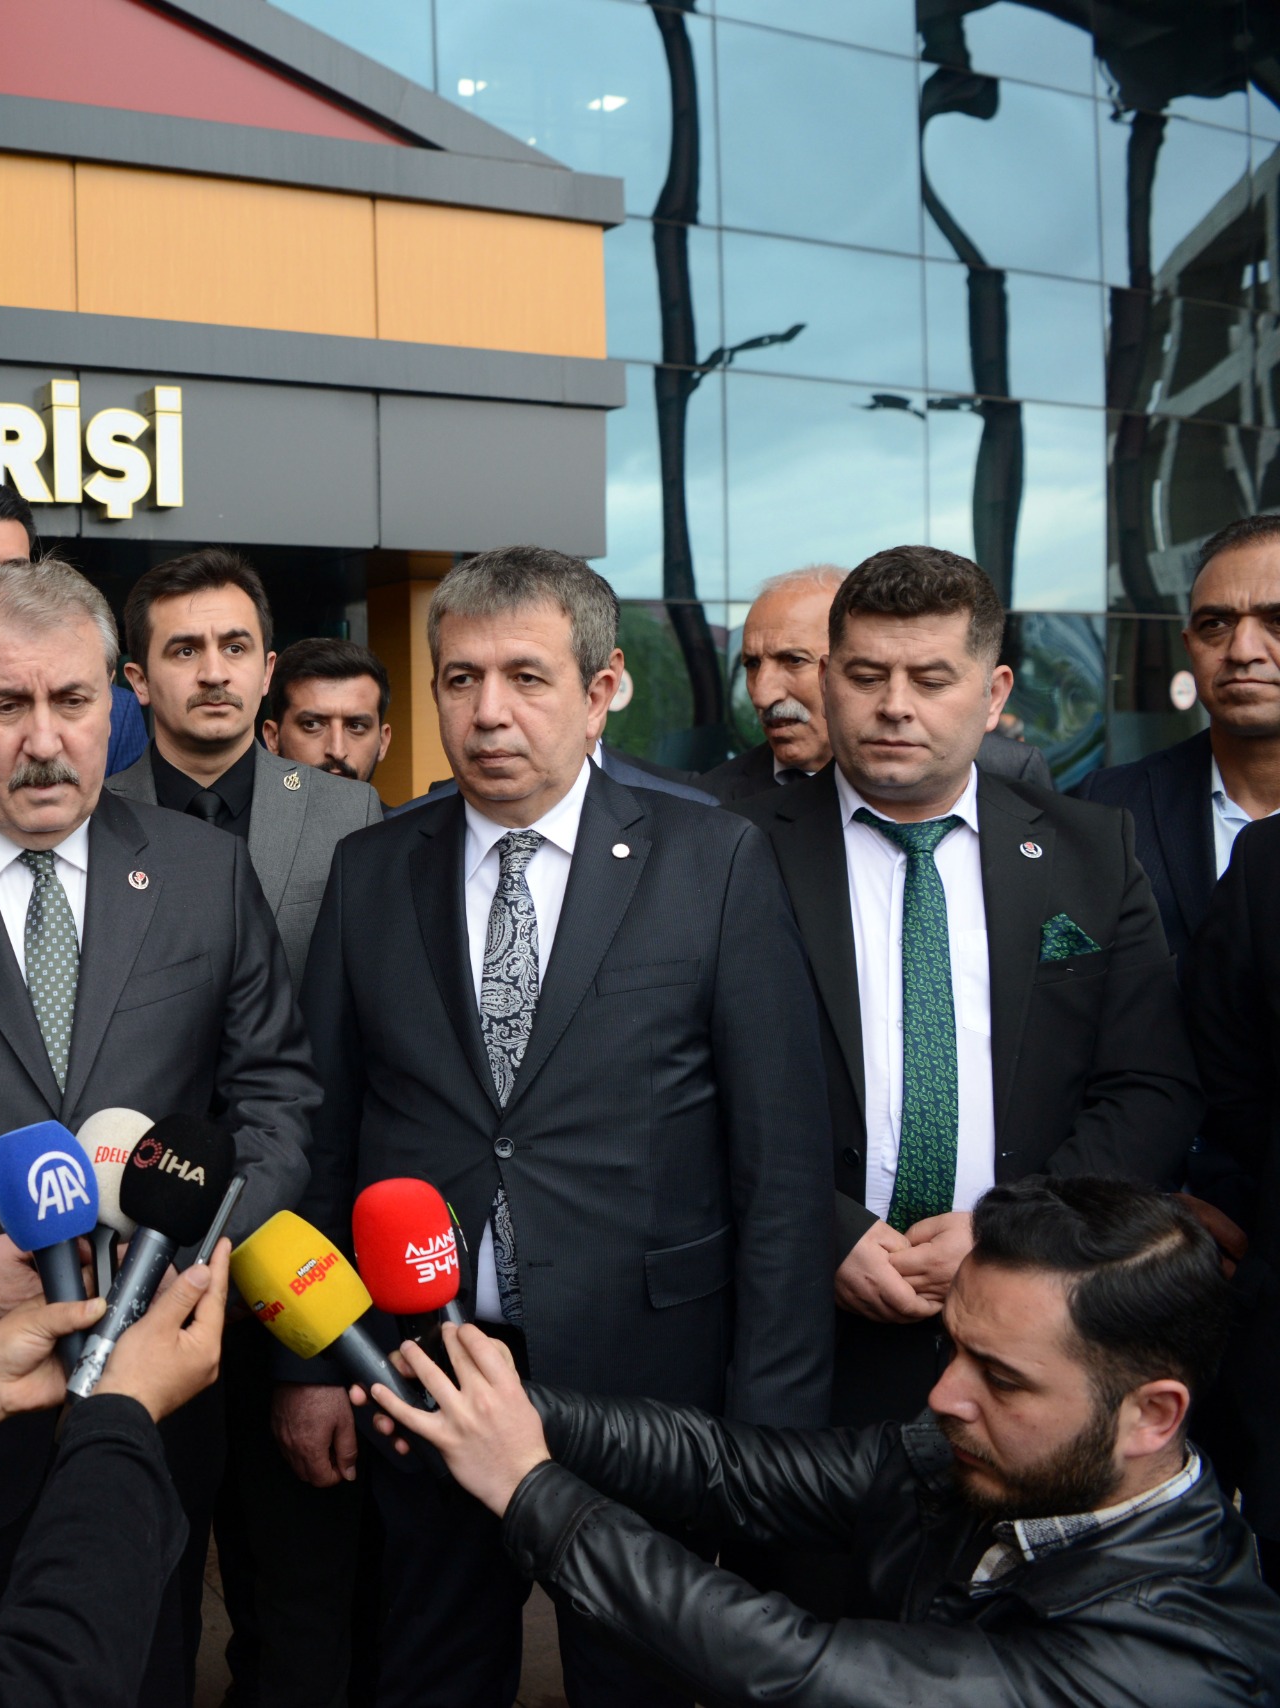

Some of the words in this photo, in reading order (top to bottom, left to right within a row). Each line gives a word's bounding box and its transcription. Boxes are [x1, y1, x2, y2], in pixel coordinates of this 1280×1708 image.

[94, 1145, 131, 1164] EDELE
[158, 1148, 205, 1186] İHA
[34, 1160, 91, 1220] AA
[289, 1252, 339, 1296] Bugün
[415, 1250, 459, 1283] 344
